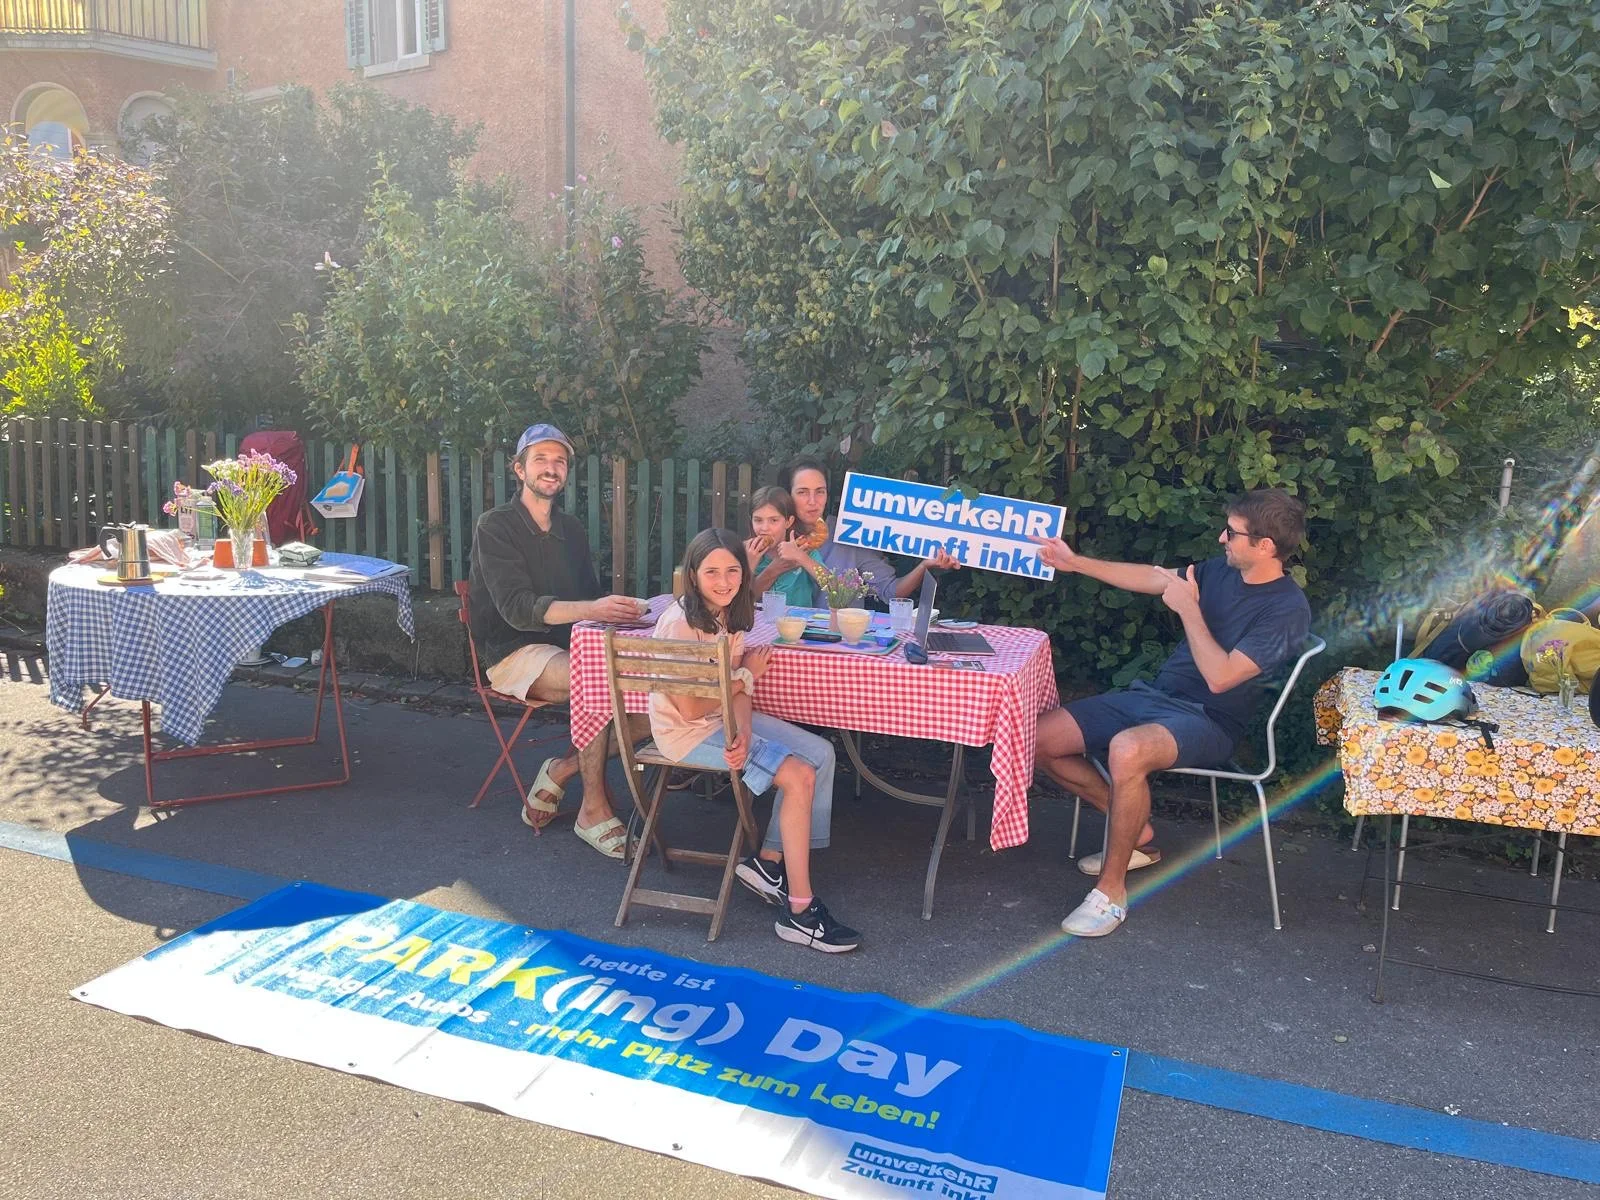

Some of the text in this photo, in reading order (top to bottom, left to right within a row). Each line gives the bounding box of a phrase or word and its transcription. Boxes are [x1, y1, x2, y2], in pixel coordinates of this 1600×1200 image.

[851, 487, 1053, 538] umverkehR
[838, 518, 1050, 578] Zukunft inkl.
[579, 954, 717, 991] heute ist
[397, 991, 492, 1023] Autos
[524, 1023, 618, 1049] mehr
[620, 1041, 713, 1075] Platz
[717, 1067, 800, 1098] zum
[810, 1083, 941, 1130] Leben!
[764, 1017, 963, 1098] Day
[841, 1160, 936, 1192] Zukunft
[853, 1147, 993, 1191] umverkehR
